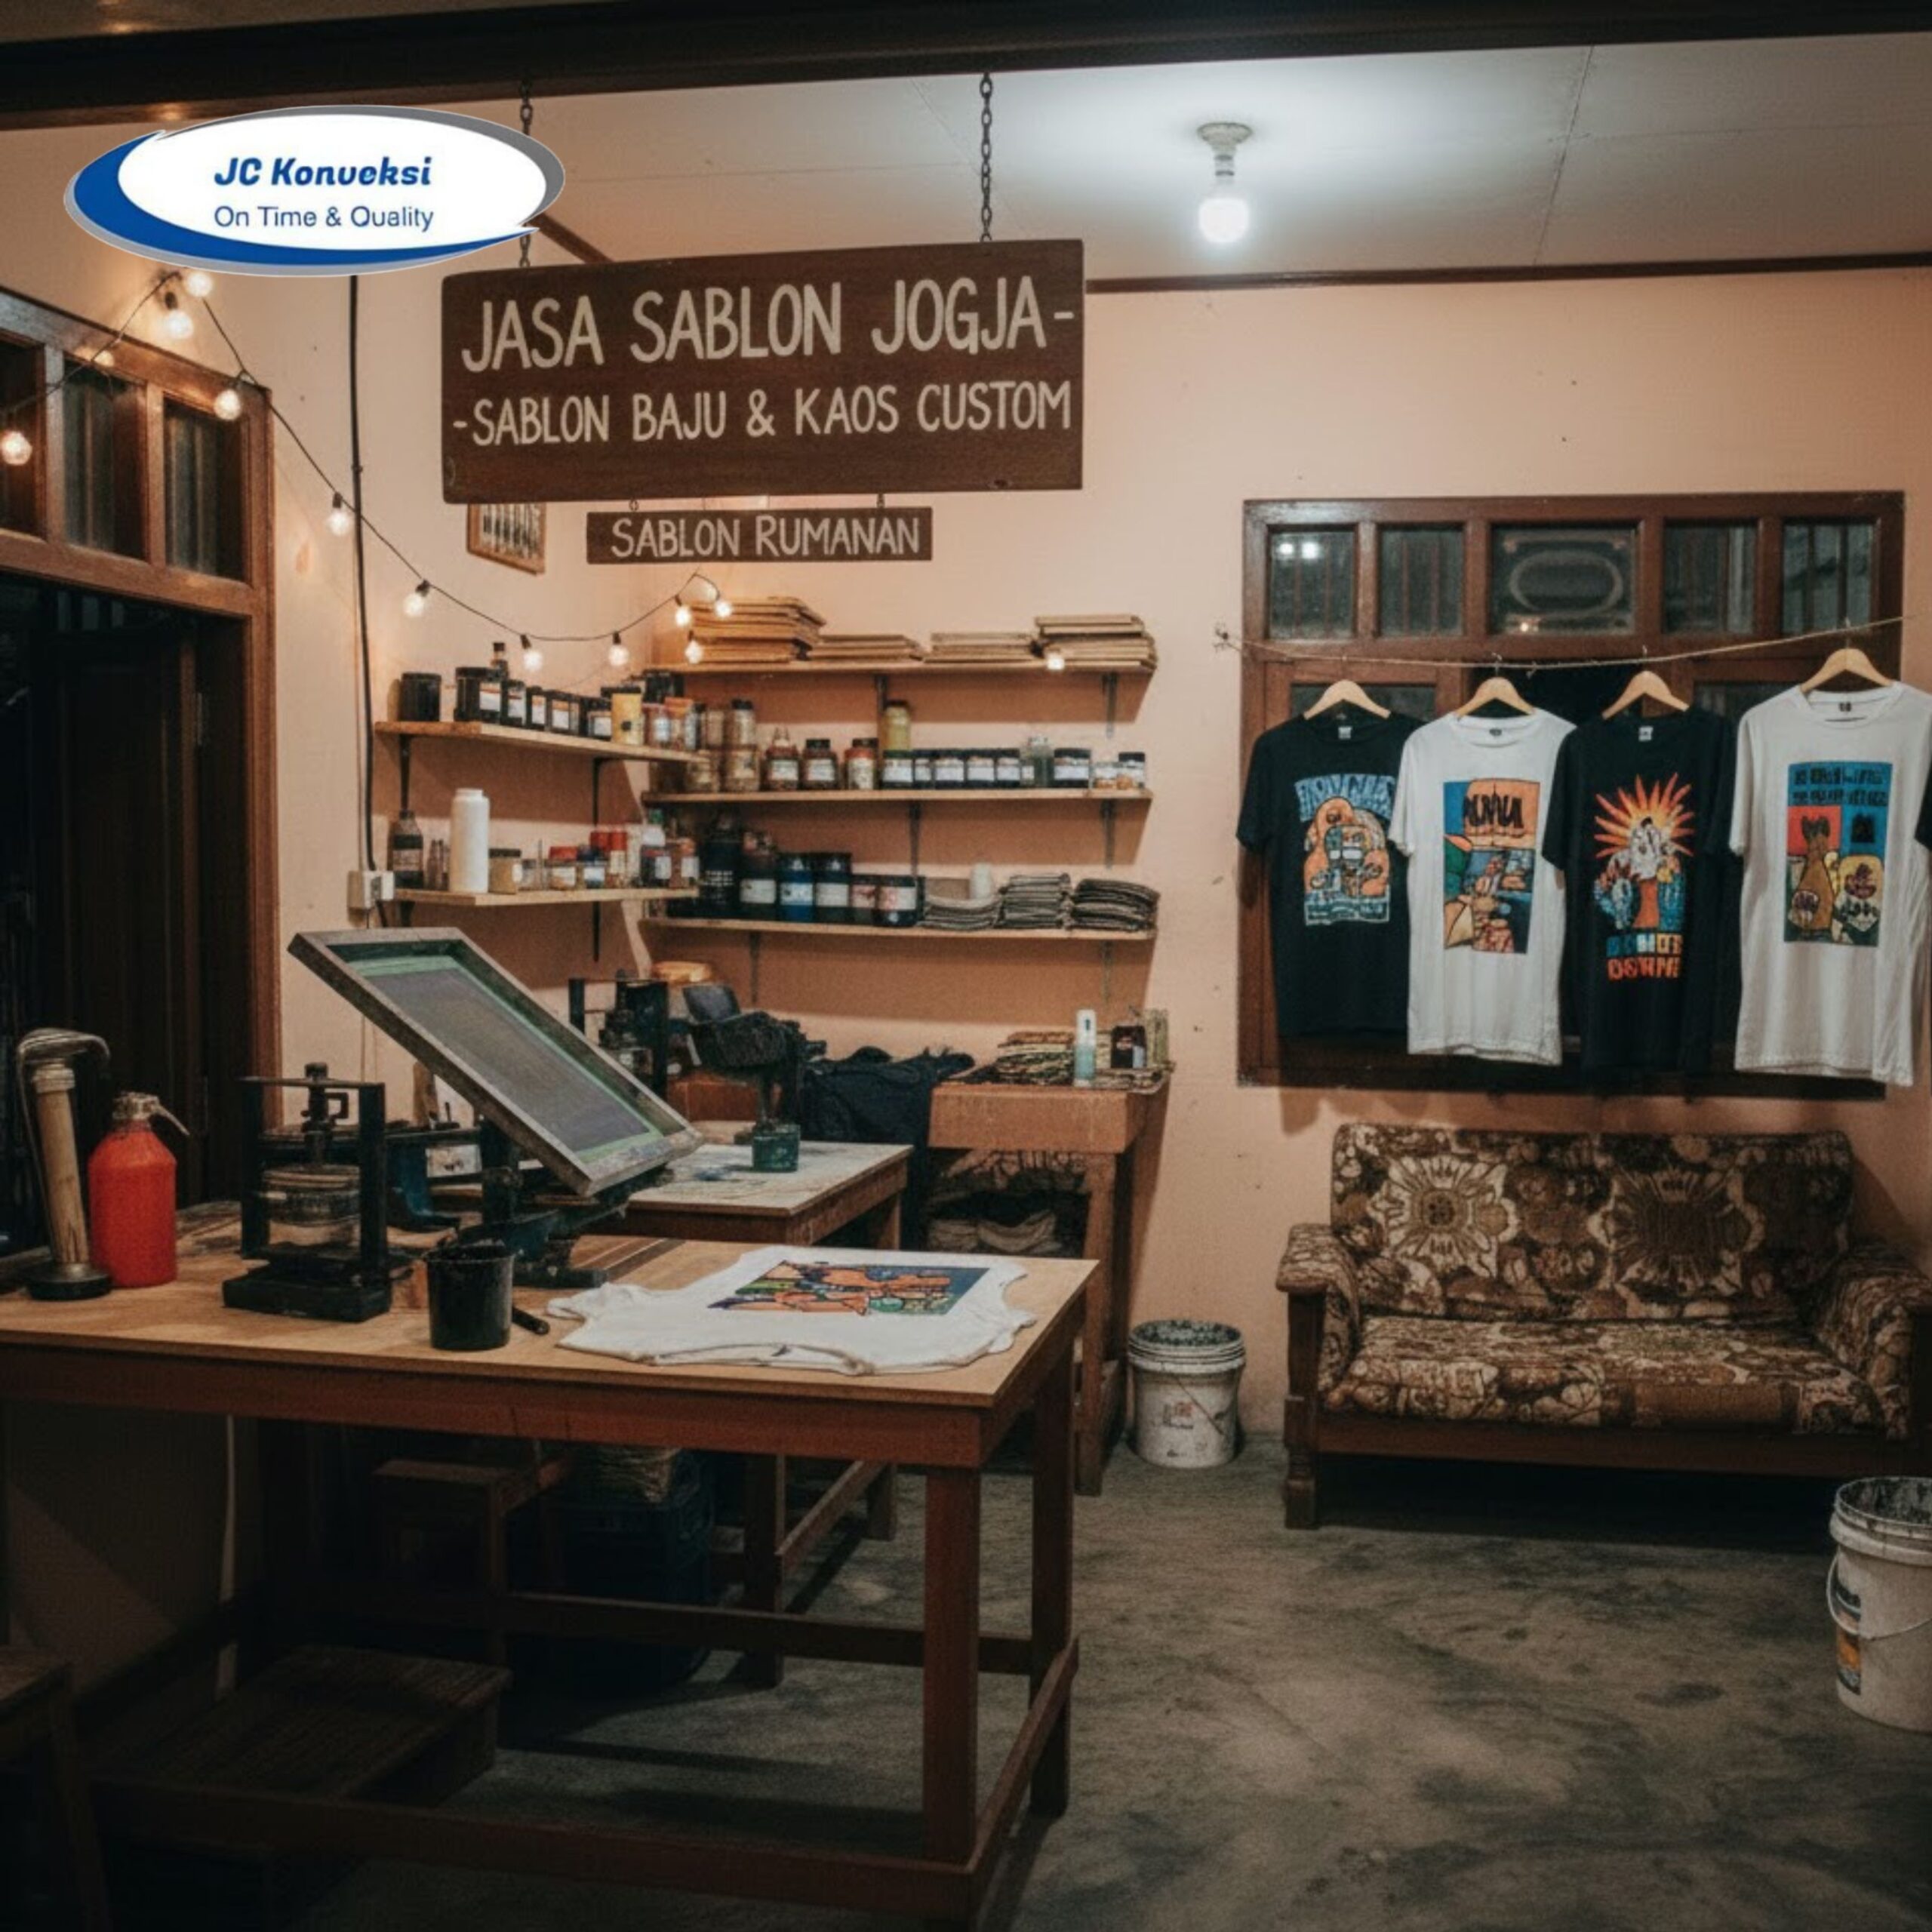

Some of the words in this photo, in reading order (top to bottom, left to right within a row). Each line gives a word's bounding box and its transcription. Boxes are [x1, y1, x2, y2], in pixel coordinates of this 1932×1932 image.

[462, 296, 604, 372] JASA
[630, 282, 841, 363] SABLON
[632, 390, 727, 441] BAJU
[746, 389, 776, 438] &
[795, 384, 900, 435] KAOS
[917, 380, 1071, 432] CUSTOM
[611, 518, 740, 558] SABLON
[756, 514, 920, 557] RUMANAN
